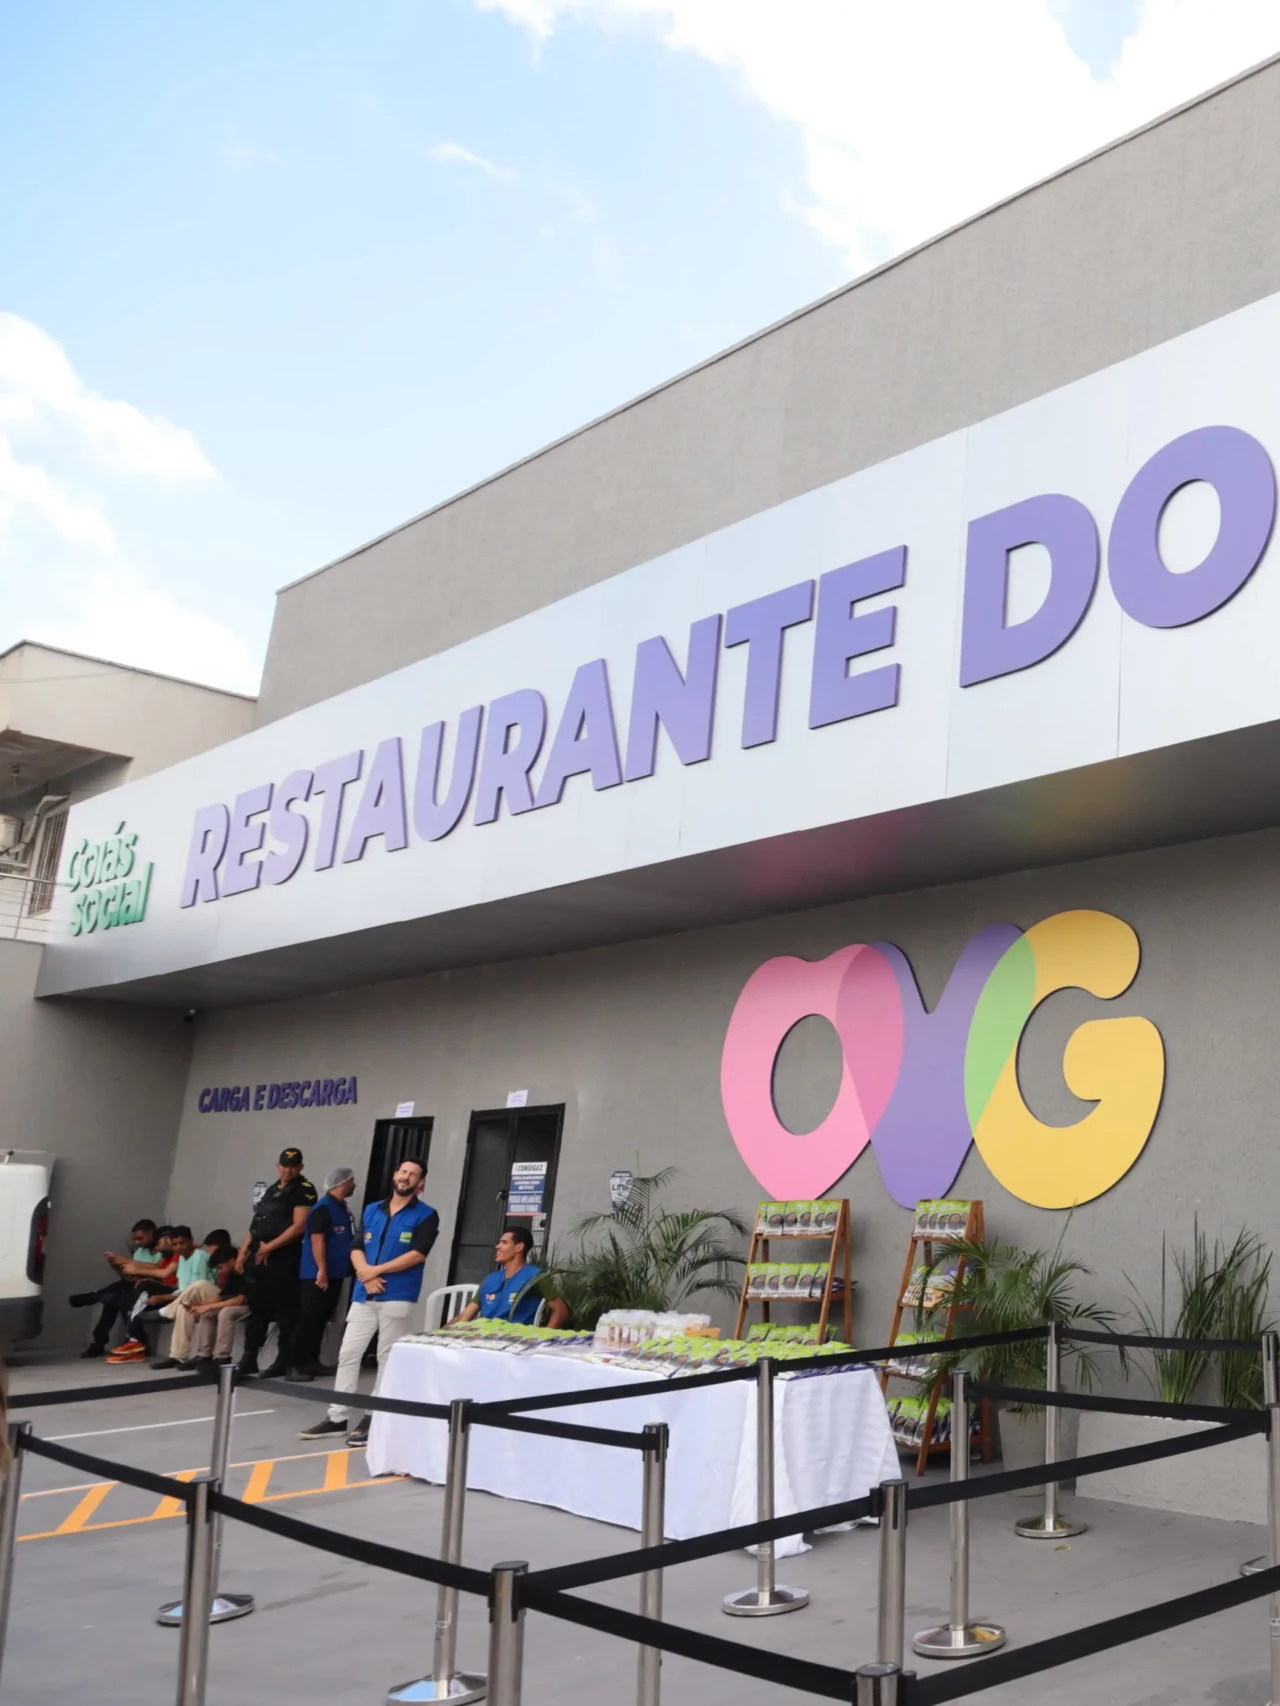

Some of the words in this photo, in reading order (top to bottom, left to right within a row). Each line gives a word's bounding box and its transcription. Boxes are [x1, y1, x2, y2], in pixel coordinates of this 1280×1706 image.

[181, 545, 908, 909] RESTAURANTE
[959, 425, 1278, 688] DO
[66, 821, 139, 892] Goiás
[199, 1086, 250, 1113] CARGA
[253, 1084, 267, 1111] E
[266, 1076, 358, 1110] DESCARGA
[720, 909, 1167, 1210] OVG
